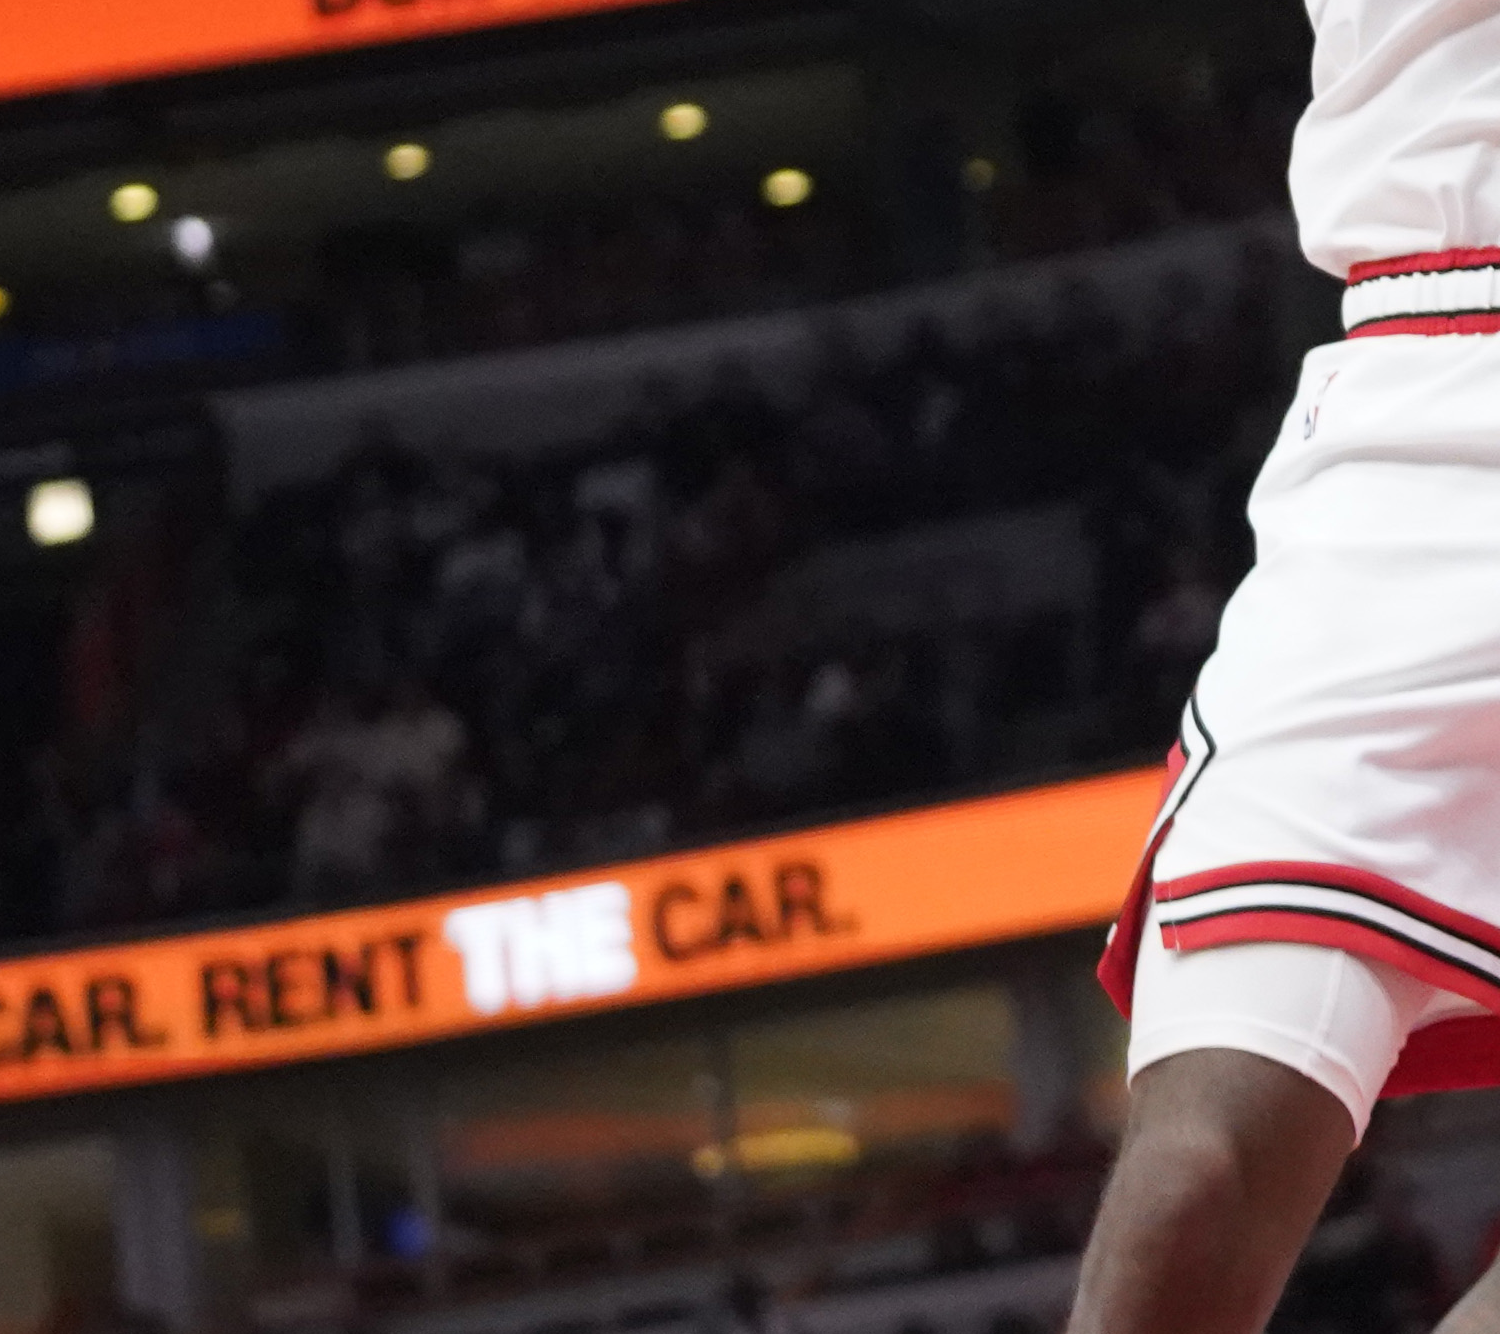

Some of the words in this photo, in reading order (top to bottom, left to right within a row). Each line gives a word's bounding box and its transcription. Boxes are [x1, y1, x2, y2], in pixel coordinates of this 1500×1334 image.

[199, 933, 428, 1040] RENT
[443, 878, 640, 1017] THE
[651, 859, 863, 964] CAR.
